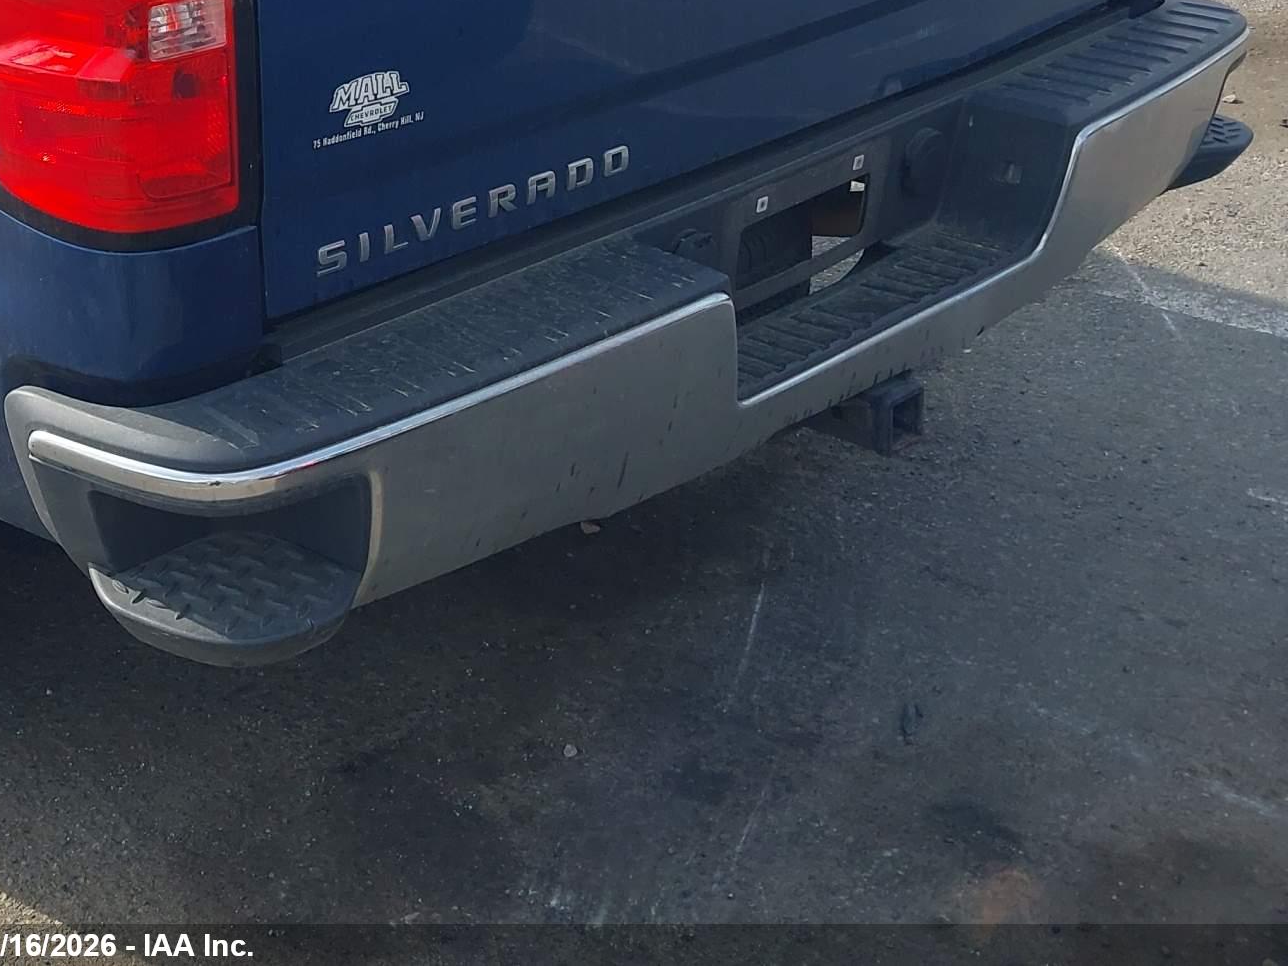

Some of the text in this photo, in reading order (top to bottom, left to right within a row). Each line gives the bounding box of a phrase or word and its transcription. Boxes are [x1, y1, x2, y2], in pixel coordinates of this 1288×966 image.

[330, 72, 409, 111] MALL
[313, 139, 321, 149] 75
[322, 128, 362, 147] Haddonfield
[377, 120, 399, 132] Cherry
[415, 111, 425, 121] NJ
[350, 105, 393, 122] CHEVROLET
[316, 145, 630, 278] SILVERADO
